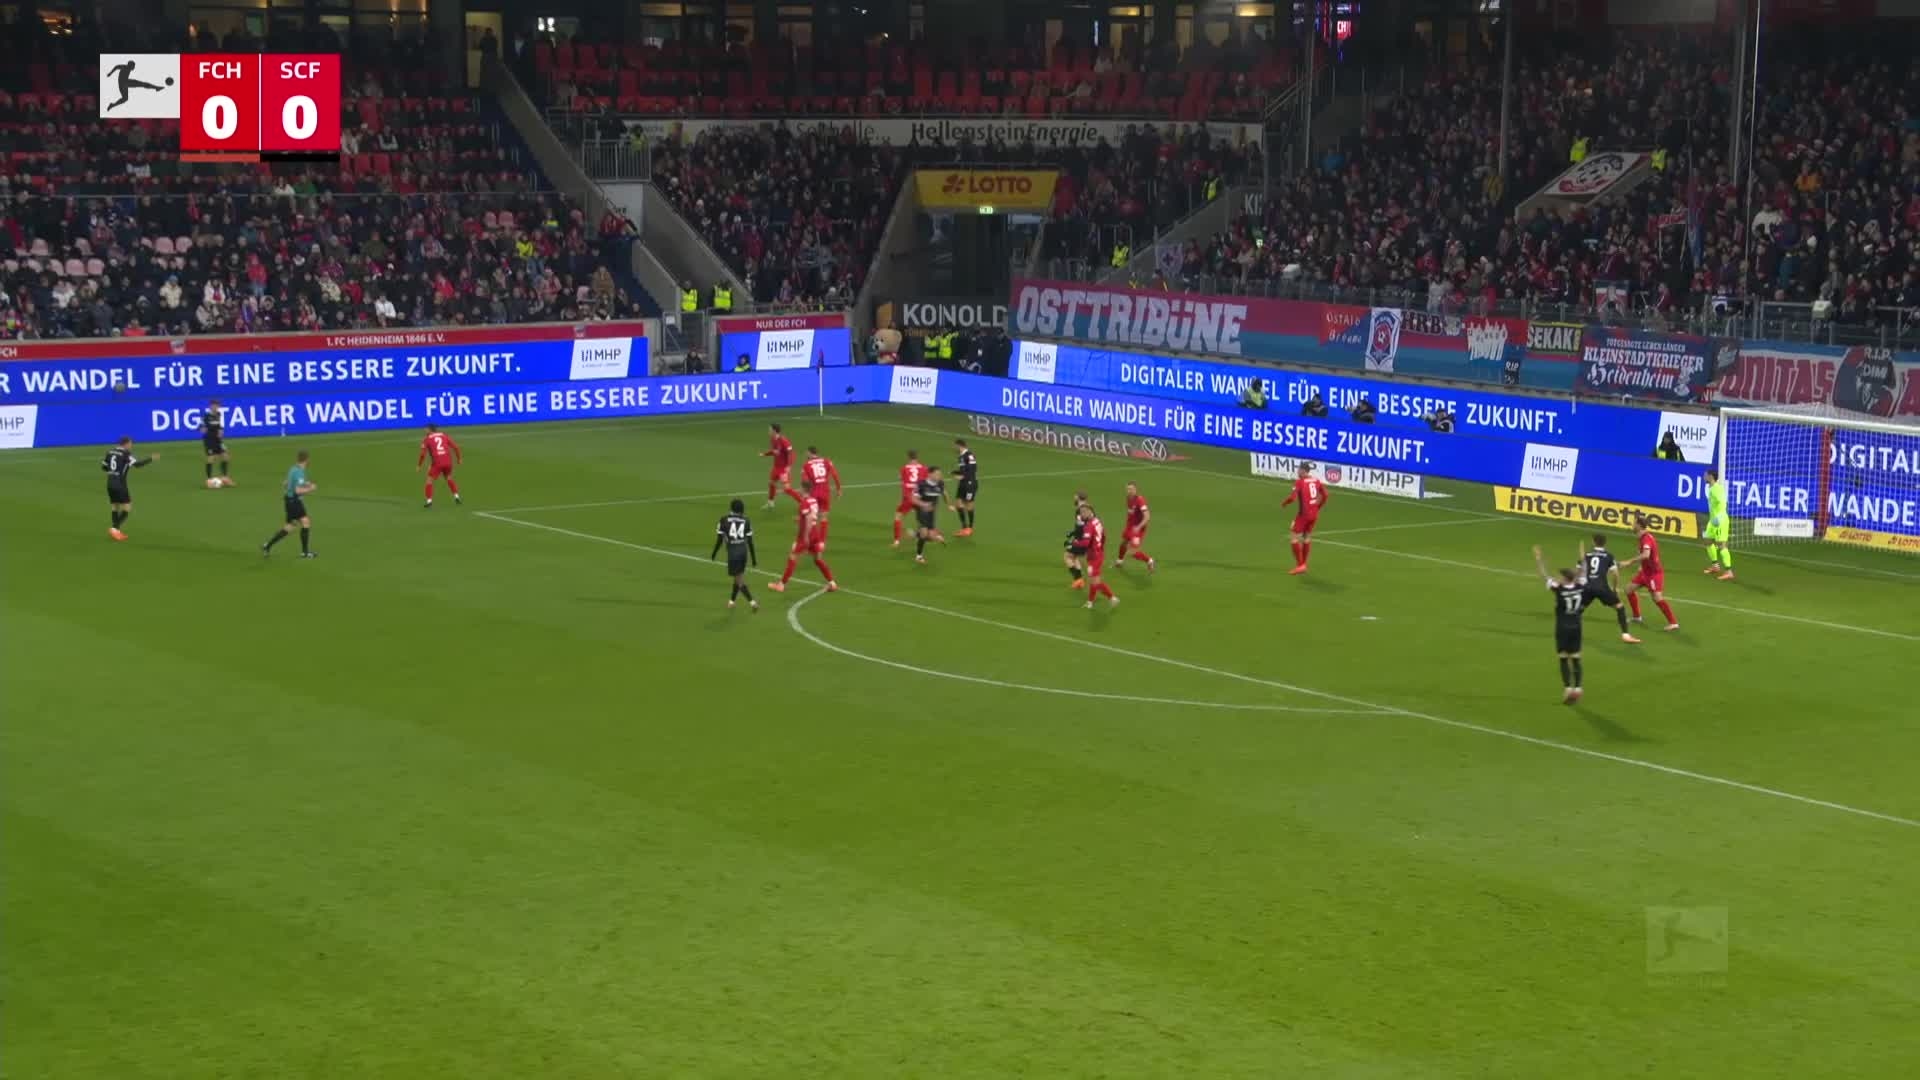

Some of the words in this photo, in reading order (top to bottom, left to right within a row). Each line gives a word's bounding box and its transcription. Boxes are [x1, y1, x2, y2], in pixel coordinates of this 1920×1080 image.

[968, 175, 1032, 194] LOTTO
[756, 320, 774, 329] NUR
[774, 319, 790, 329] DER
[791, 318, 807, 328] FCH
[903, 303, 1009, 327] KONOLD
[1016, 285, 1247, 355] OSTTRIBÜNE
[347, 335, 404, 346] HEIDENHEIM
[405, 334, 426, 344] 1846
[779, 339, 805, 353] MHP
[594, 348, 622, 361] MHP
[1583, 346, 1704, 372] KLEINSTADTKRIEGER
[22, 368, 140, 393] WANDEL
[154, 362, 204, 388] FÜR
[216, 362, 275, 385] EINE
[289, 358, 394, 382] BESSERE
[406, 353, 521, 377] ZUKUNFT.
[910, 376, 932, 389] MHP
[1587, 363, 1675, 389] Heidenheim
[152, 404, 296, 431] DIGTALER
[306, 399, 413, 424] WANDEL
[425, 392, 472, 418] FÜR
[484, 391, 538, 415] EINE
[551, 386, 649, 411] BESSERE
[660, 380, 767, 405] ZUKUNFT.
[1121, 362, 1204, 392] DIGITALER
[1466, 401, 1563, 435] ZUKUNFT.
[1002, 387, 1082, 418] DIGITALER
[1090, 400, 1157, 427] WANDEL
[1164, 404, 1196, 433] FÜR
[1204, 413, 1244, 440] EINE
[1251, 419, 1328, 451] BESSERE
[1336, 431, 1431, 464] ZUKUNFT.
[1681, 426, 1707, 441] MHP
[434, 436, 444, 451] 2
[975, 414, 1134, 457] Bierschneider
[110, 455, 117, 471] 6
[810, 462, 827, 478] 16
[1543, 456, 1568, 472] MHP
[908, 467, 919, 482] 3
[1370, 472, 1414, 490] MHP
[1509, 487, 1683, 533] interwetten
[728, 521, 745, 540] 44
[1590, 556, 1600, 575] 9
[1563, 594, 1583, 615] 17
